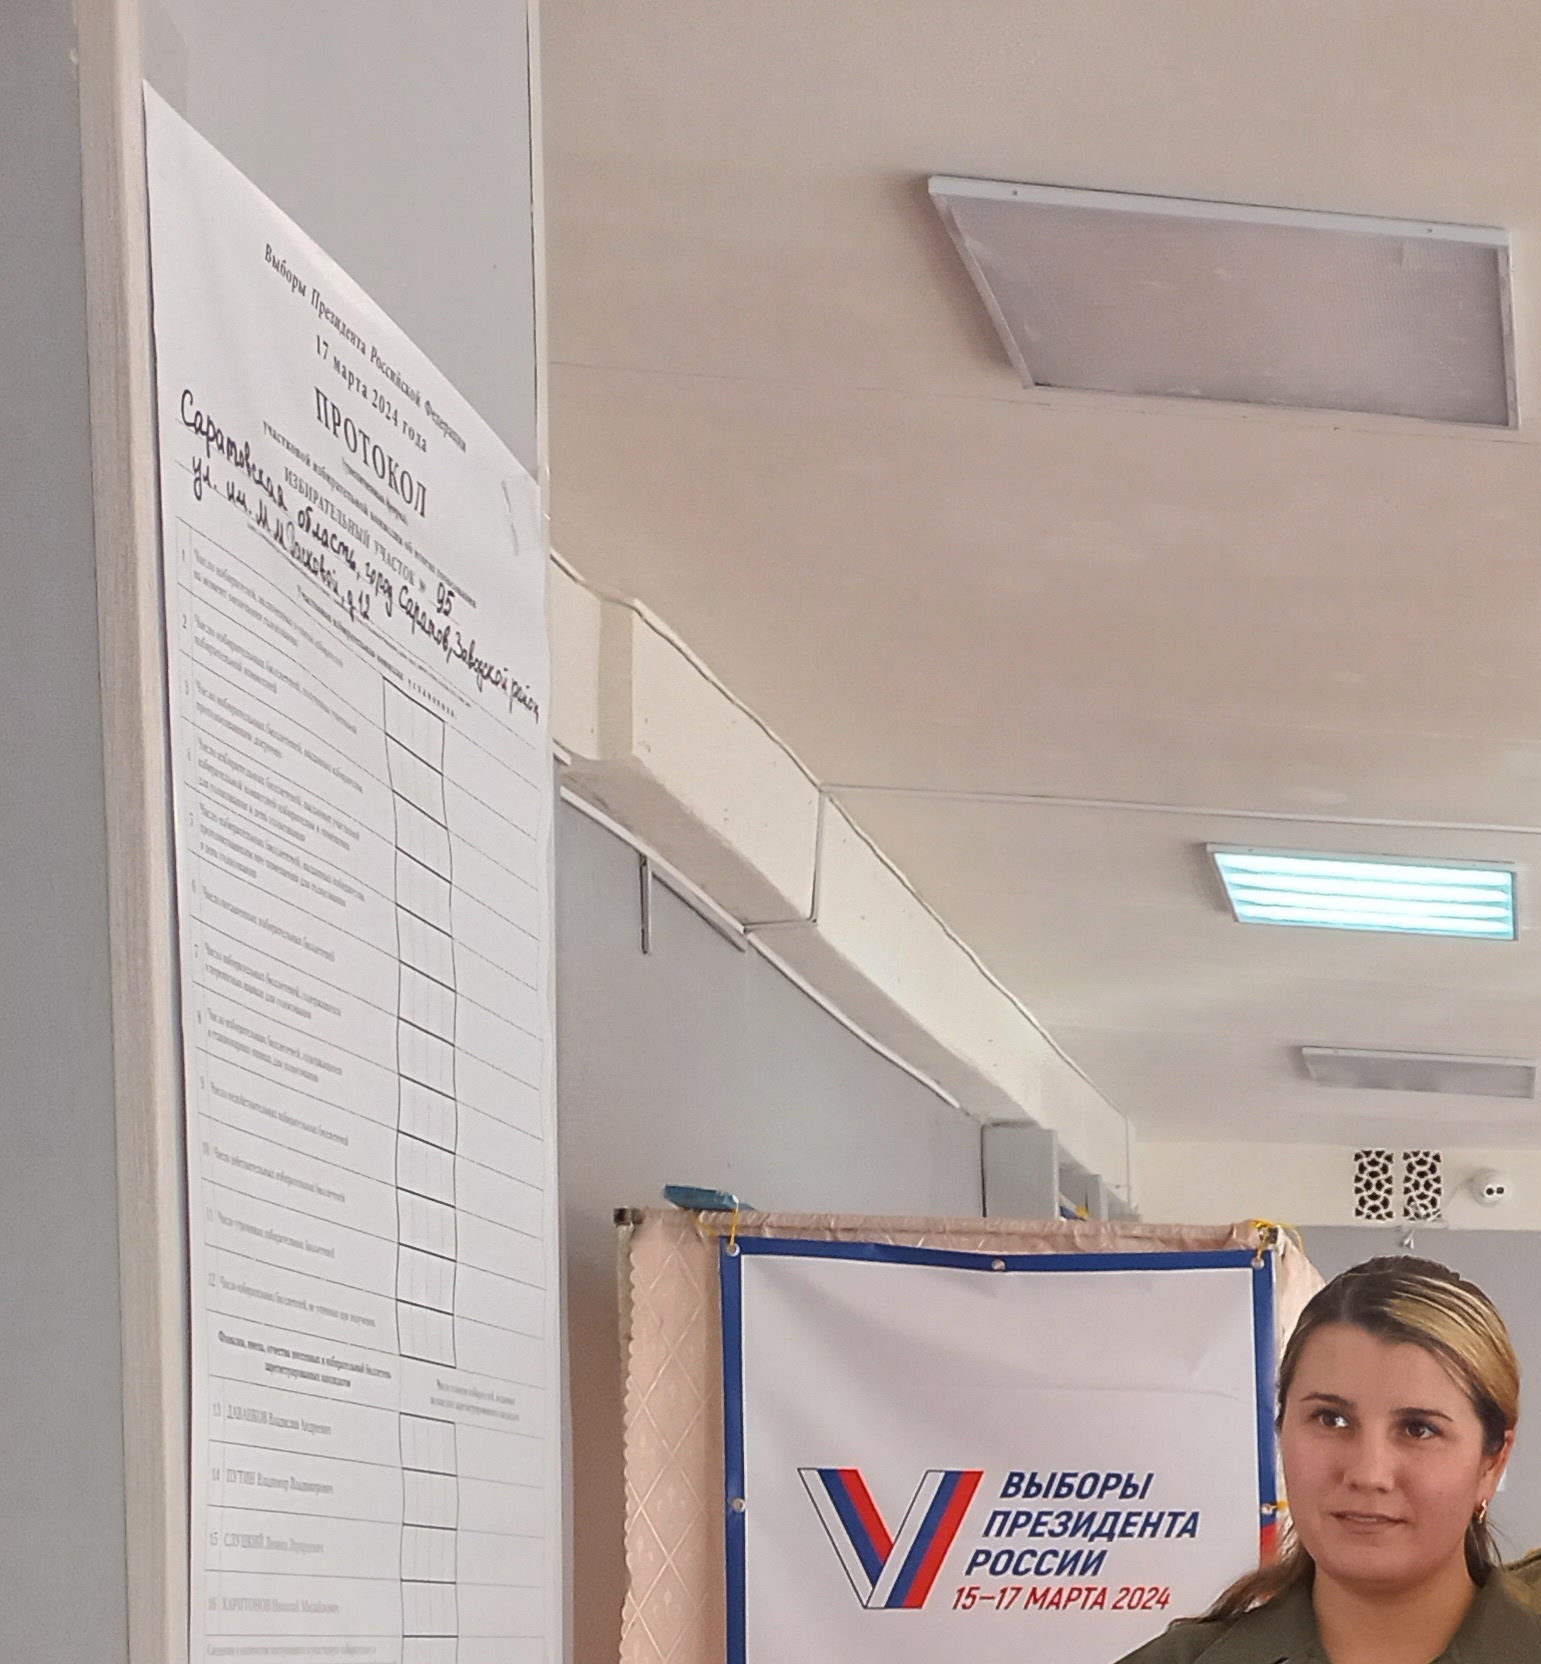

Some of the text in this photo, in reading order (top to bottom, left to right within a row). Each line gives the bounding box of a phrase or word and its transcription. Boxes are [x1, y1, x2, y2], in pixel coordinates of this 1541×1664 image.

[264, 243, 306, 296] Выборы
[310, 288, 366, 354] Президента
[370, 345, 420, 406] Российской
[316, 334, 426, 452] 17 марта 2024 года
[180, 389, 288, 510] Саратовская
[191, 456, 217, 500] ул.
[315, 387, 425, 516] ПРОТОКОЛ
[284, 467, 369, 548] ИЗБИРАТЕЛЬНЫЙ
[374, 540, 414, 586] УЧАСТОК
[436, 581, 455, 616] 95
[998, 1469, 1155, 1501] ВЫБОРЫ
[965, 1547, 1108, 1579] РОССИИ
[982, 1508, 1201, 1544] ПРЕЗИДЕНТА
[1023, 1585, 1110, 1611] МАРТА
[1111, 1586, 1171, 1610] 2024
